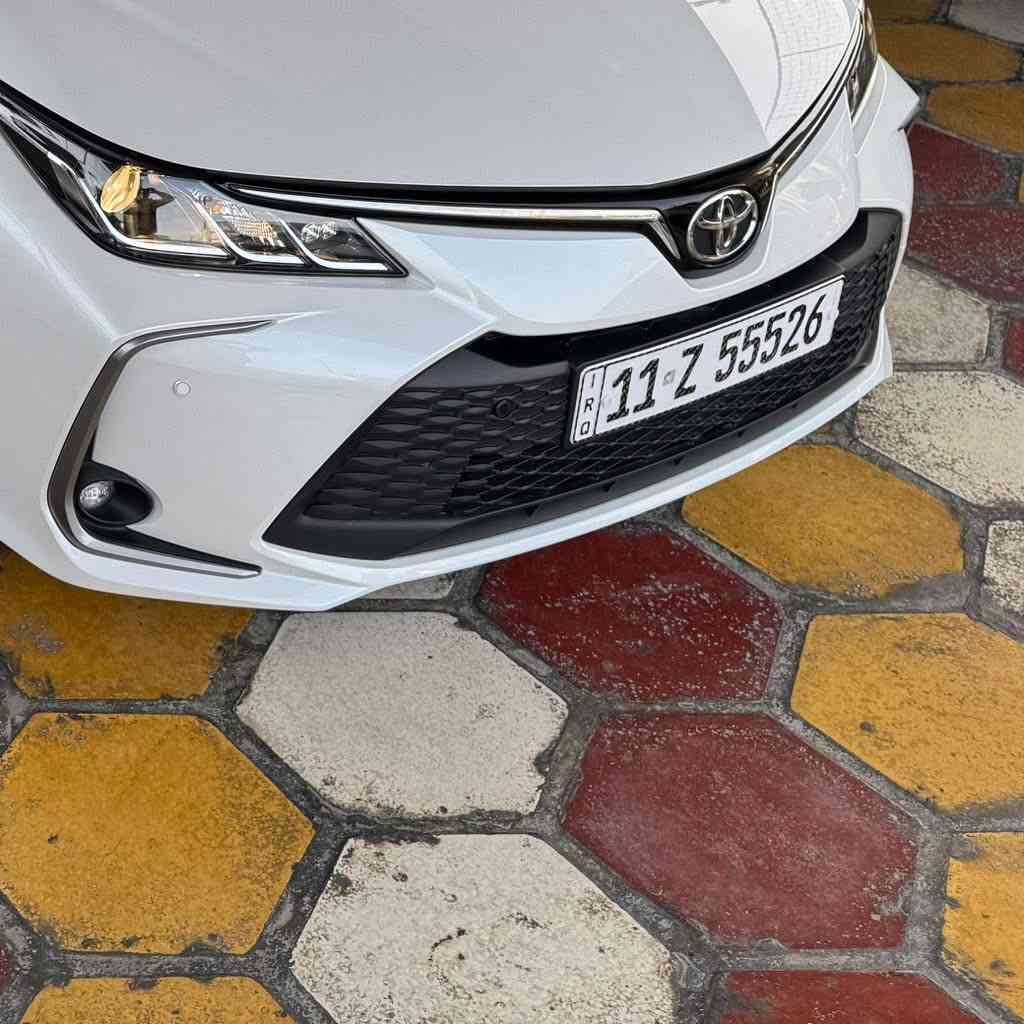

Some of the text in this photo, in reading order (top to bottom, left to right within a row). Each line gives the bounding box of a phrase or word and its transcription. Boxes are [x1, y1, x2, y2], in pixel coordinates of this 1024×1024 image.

[606, 294, 826, 423] 11 Z 55526
